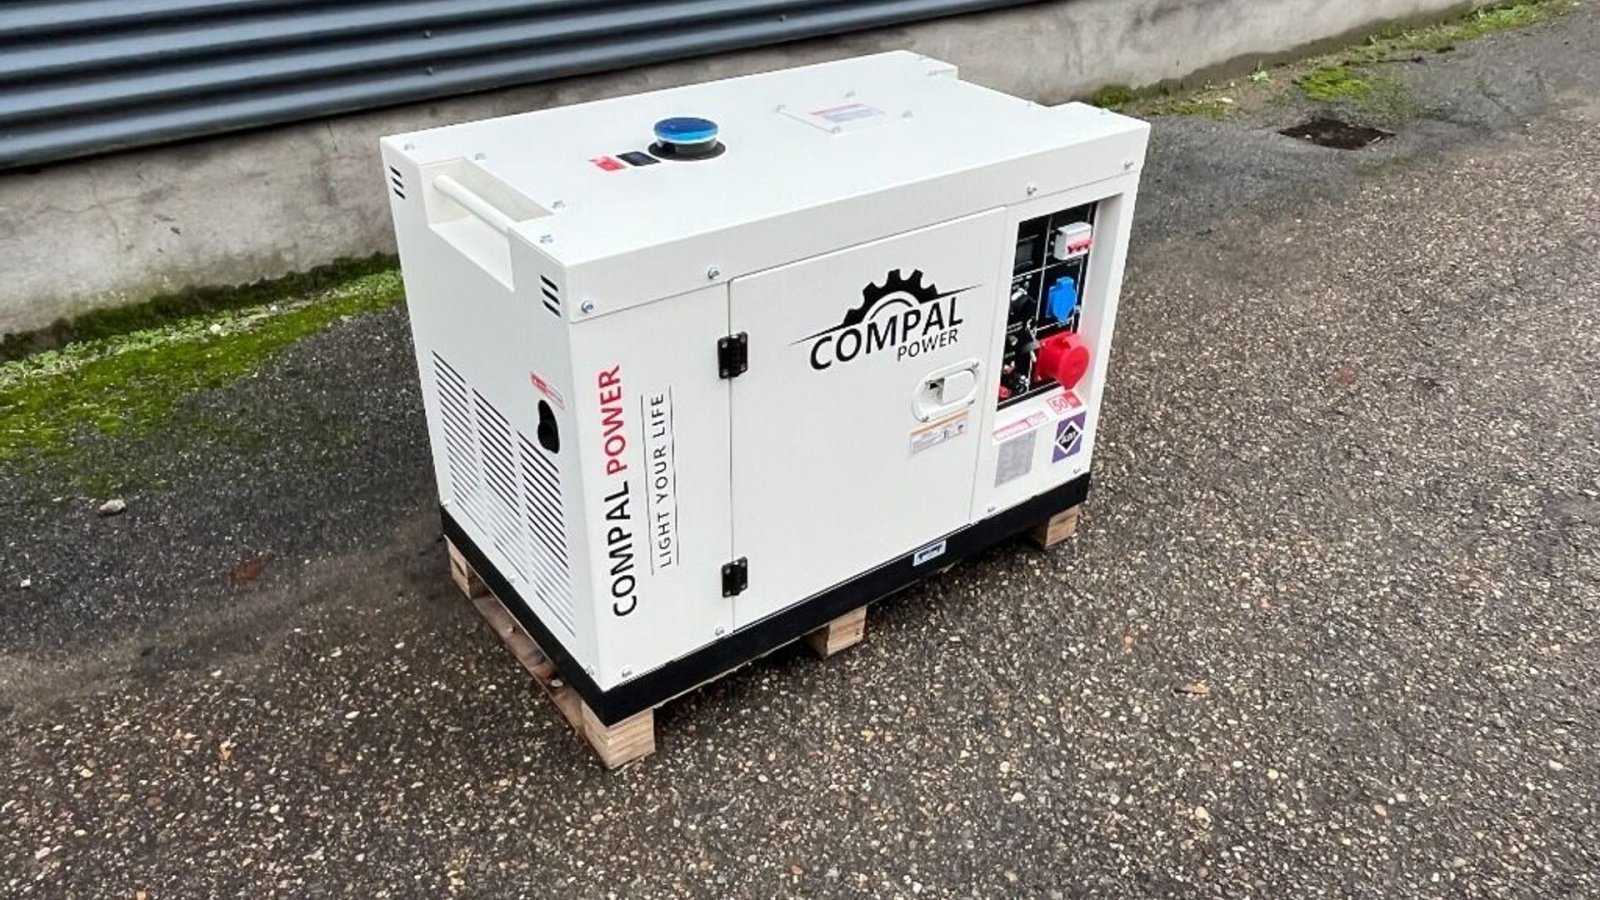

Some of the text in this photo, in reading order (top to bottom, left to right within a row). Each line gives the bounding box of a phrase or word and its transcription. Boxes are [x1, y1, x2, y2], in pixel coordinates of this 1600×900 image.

[810, 297, 963, 370] COMPAL
[897, 328, 958, 362] POWER
[599, 365, 637, 617] COMPAL POWER
[651, 394, 671, 568] LIGHT YOUR LIFE
